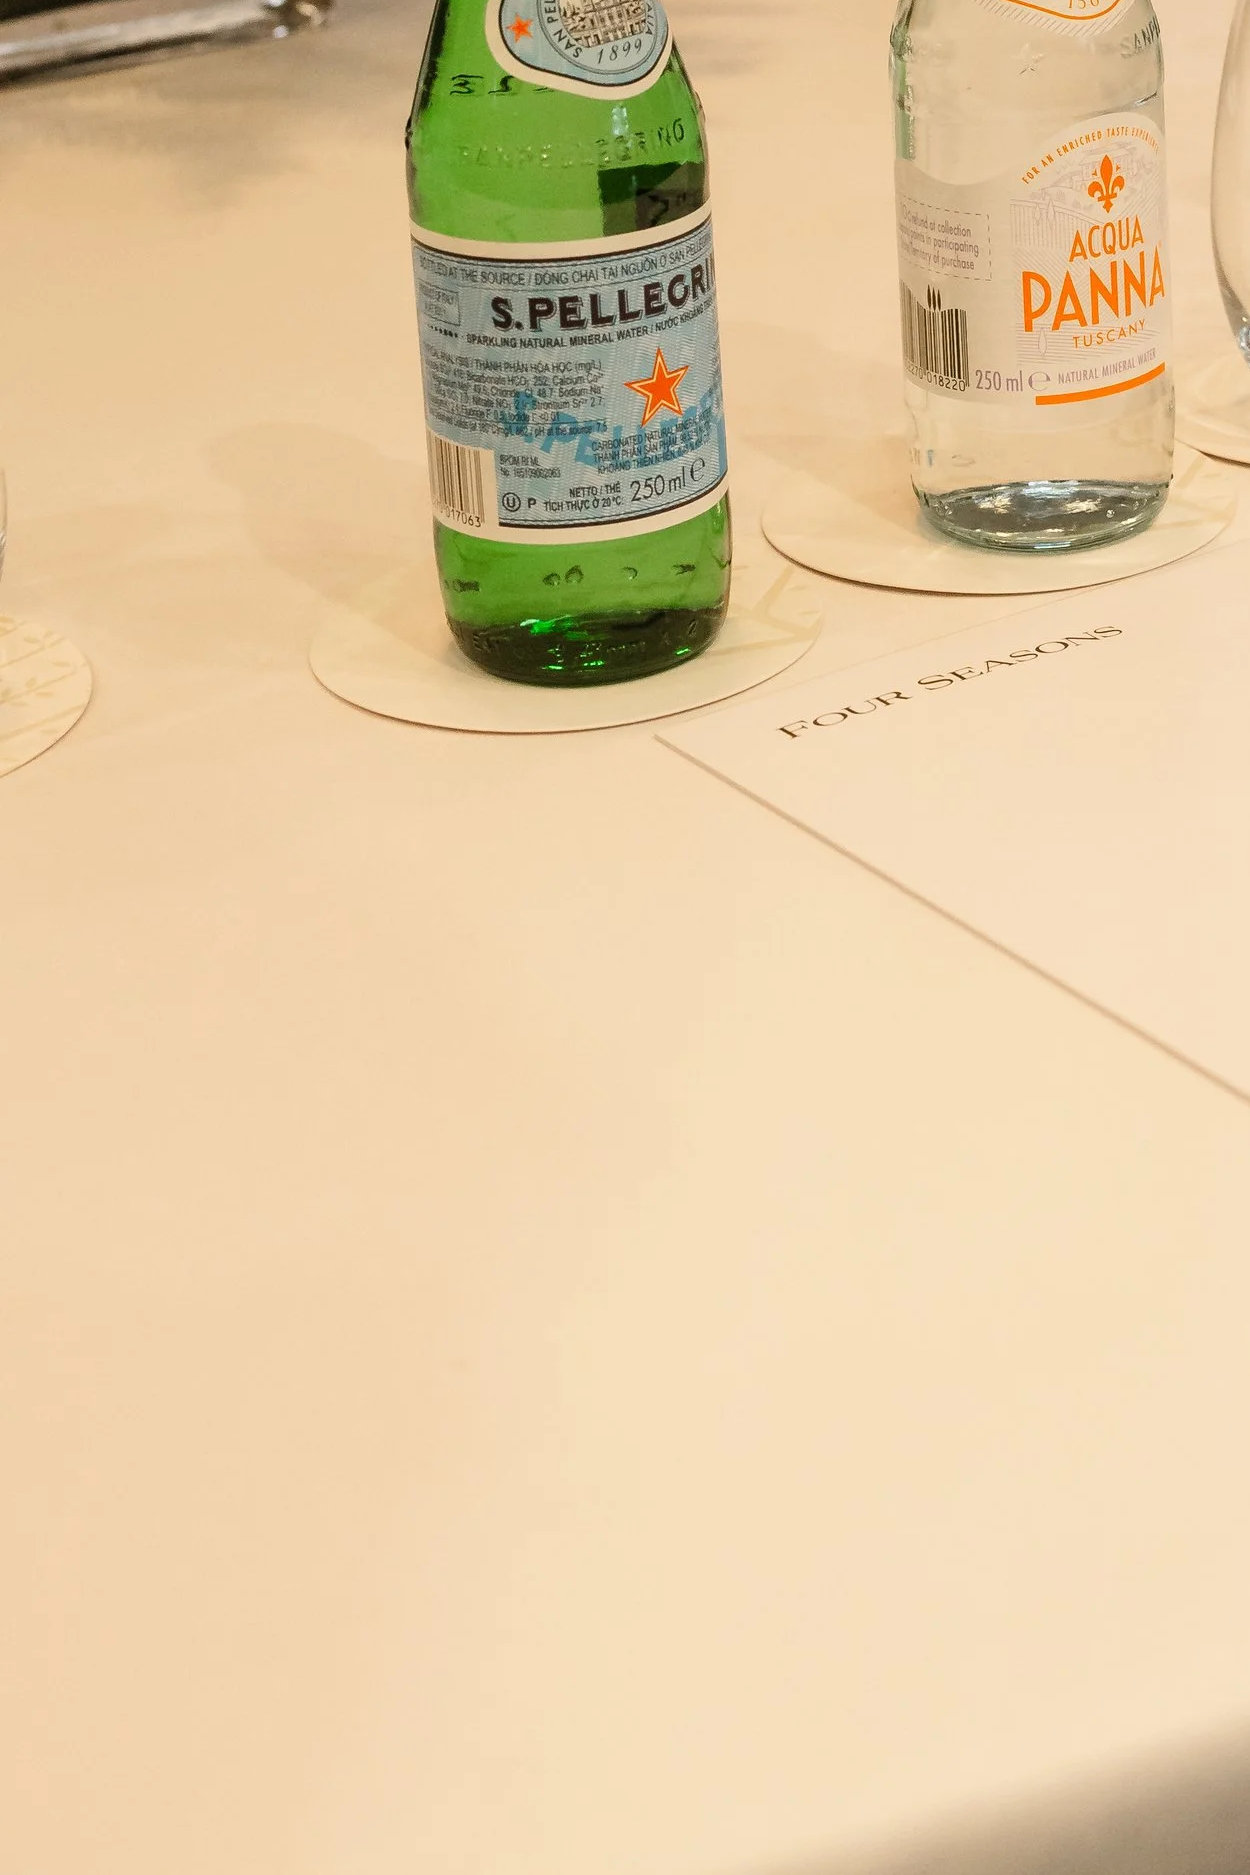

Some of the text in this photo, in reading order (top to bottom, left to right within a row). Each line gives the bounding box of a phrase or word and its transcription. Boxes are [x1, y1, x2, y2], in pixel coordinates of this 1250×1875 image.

[553, 28, 583, 59] SAN
[597, 40, 643, 65] 1899
[1022, 167, 1041, 185] FOR
[1040, 154, 1055, 168] AN
[1056, 130, 1102, 157] ENRICHED
[1106, 126, 1129, 138] TASTE
[938, 219, 971, 237] collection
[1069, 214, 1144, 263] ACQUA
[933, 237, 979, 258] participating
[933, 250, 939, 264] of
[941, 256, 975, 270] purchase
[460, 268, 478, 283] THE
[481, 270, 525, 285] SOURCE
[572, 270, 598, 284] CHAI
[669, 250, 685, 265] SAN
[1022, 246, 1165, 333] PANNA
[467, 333, 517, 348] SPARKLING
[520, 337, 567, 349] NATURAL
[570, 333, 614, 347] MINERAL
[617, 325, 648, 340] WATER
[1073, 319, 1145, 349] TUSCANY
[1058, 347, 1157, 385] NATURAL MINERAL WATER
[975, 370, 1002, 391] 250
[1006, 370, 1023, 392] ml
[591, 433, 643, 452] CARBONATED
[528, 498, 537, 509] P
[569, 486, 599, 498] NETTO
[775, 625, 1124, 739] FOUR SEASONS
